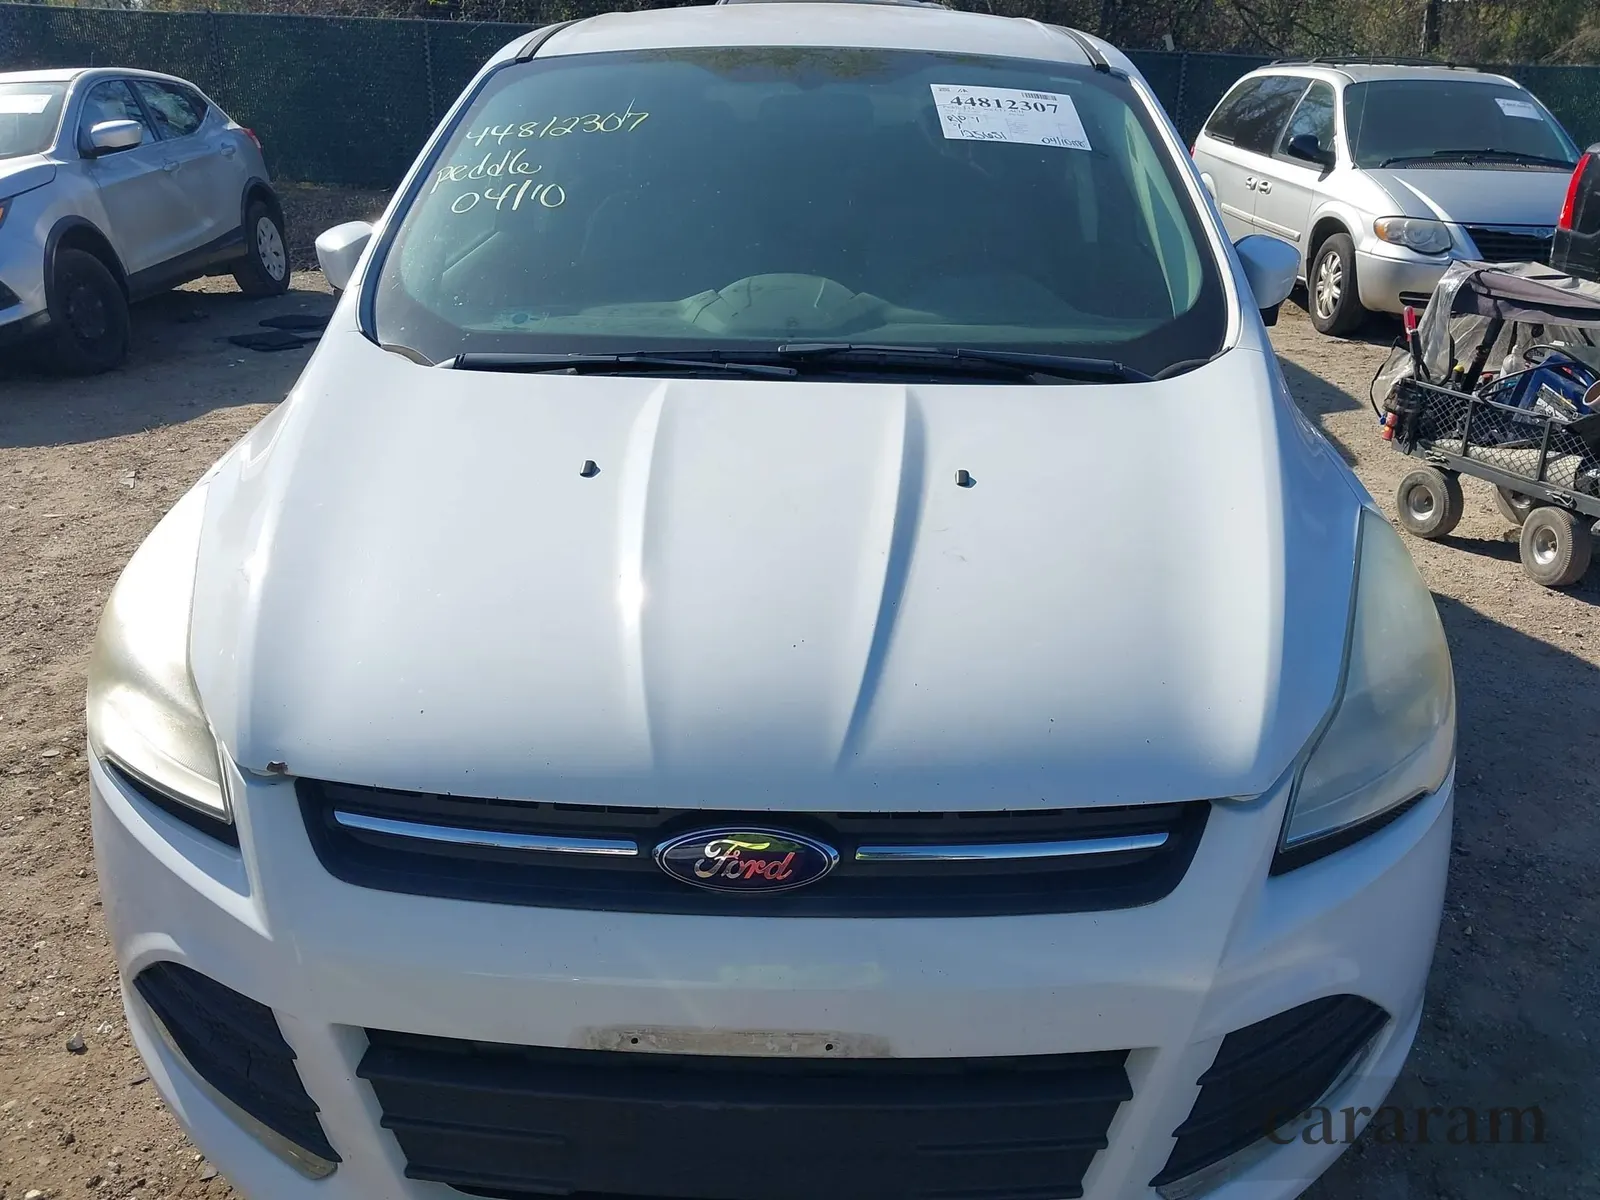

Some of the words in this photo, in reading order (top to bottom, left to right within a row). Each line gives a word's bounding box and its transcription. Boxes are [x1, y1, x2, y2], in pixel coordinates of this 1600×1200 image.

[466, 98, 649, 147] 44812307
[950, 96, 1058, 114] 44812307
[451, 180, 566, 214] 04/10
[694, 839, 796, 881] Ford
